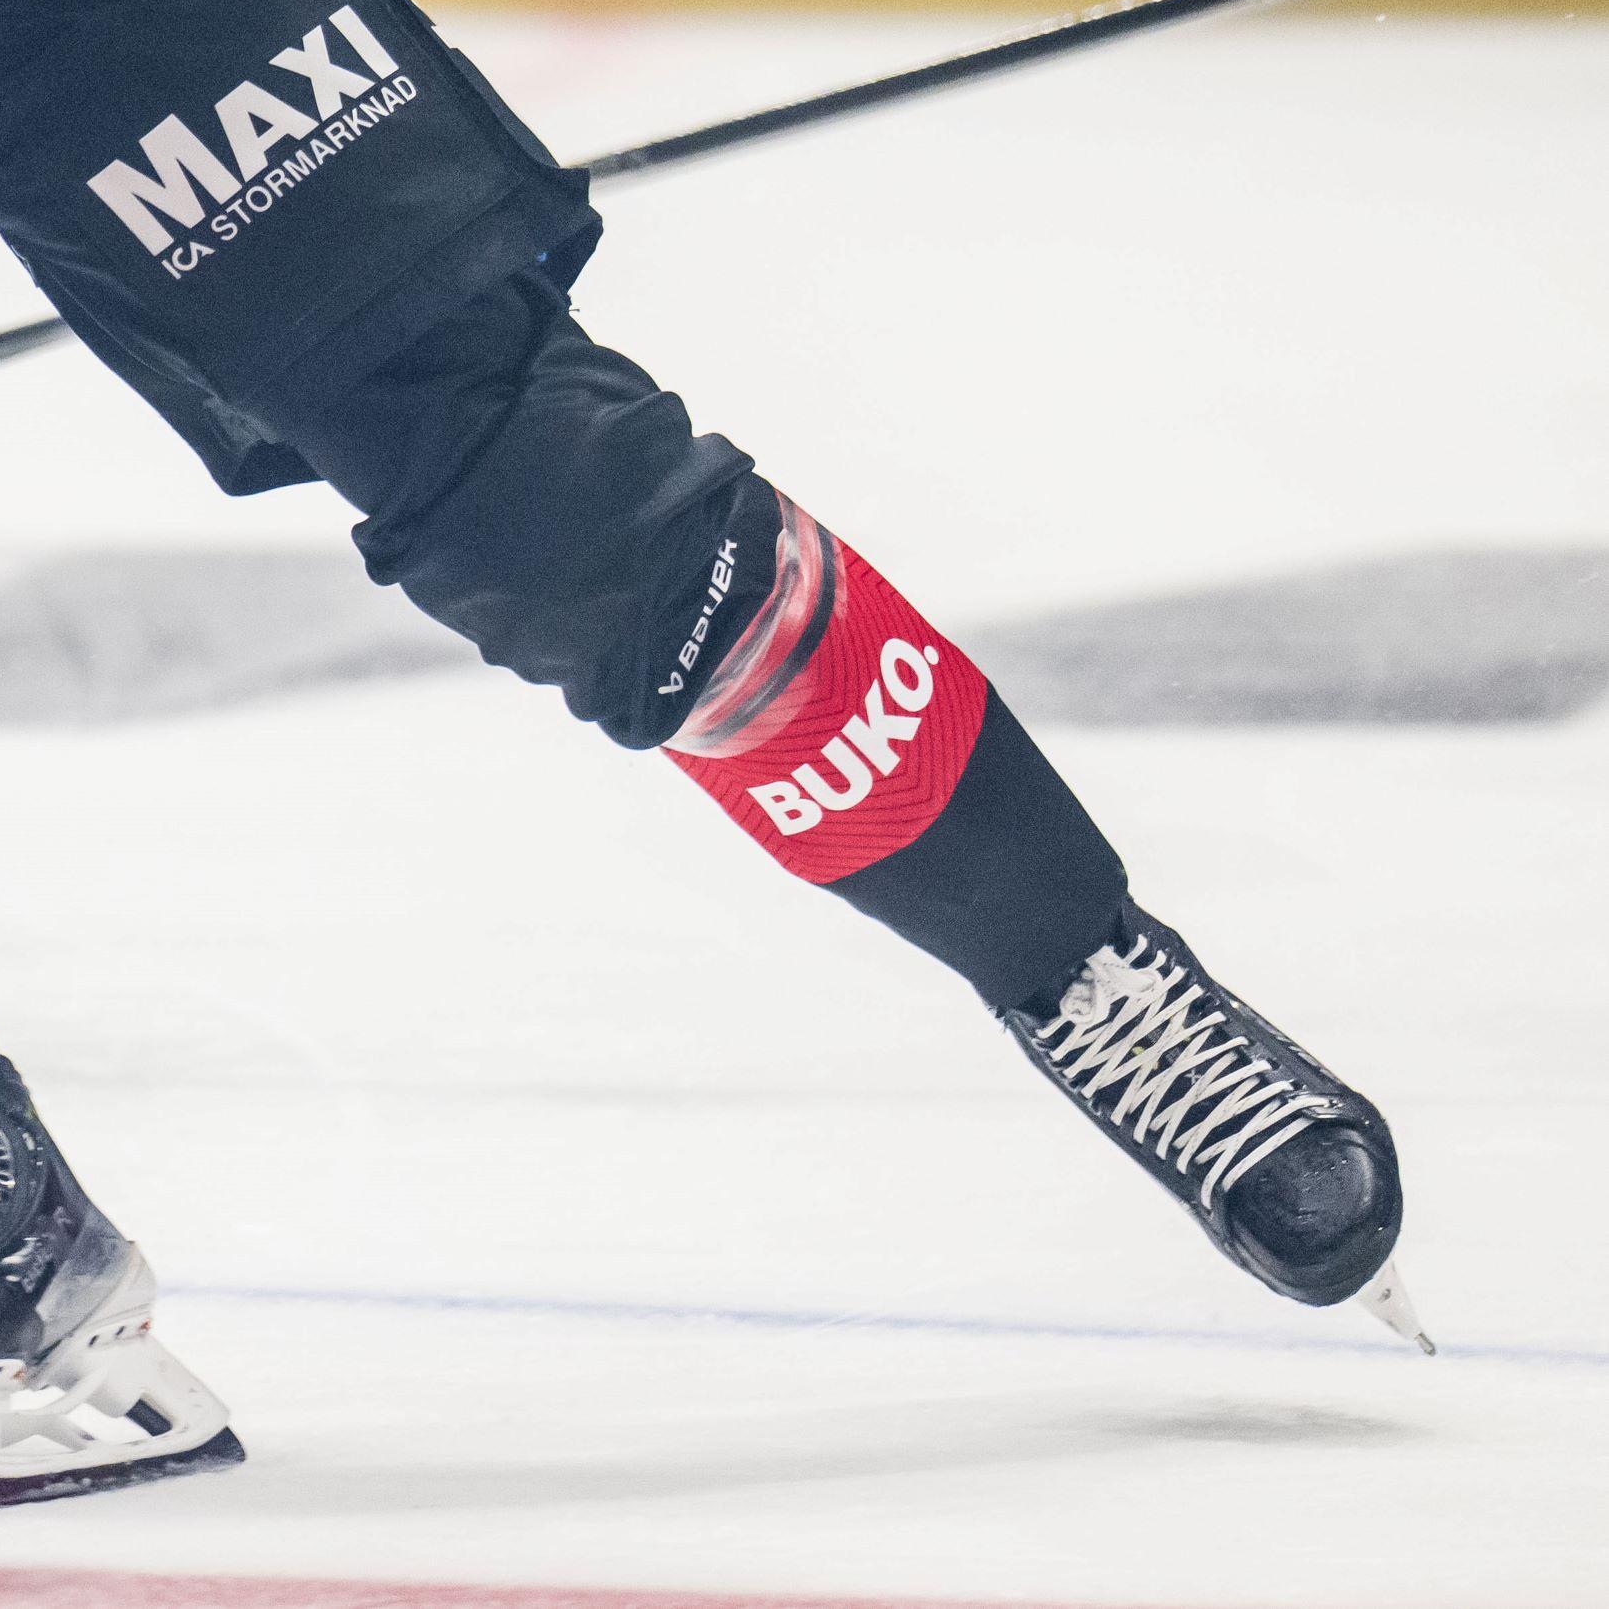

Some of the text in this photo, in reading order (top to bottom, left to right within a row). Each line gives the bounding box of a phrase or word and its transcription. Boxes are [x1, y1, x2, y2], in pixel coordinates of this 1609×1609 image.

[85, 3, 401, 258] MAXI
[160, 73, 418, 280] ICA STORMARKNAD
[678, 537, 738, 672] BAUER
[746, 636, 939, 837] BUKO.
